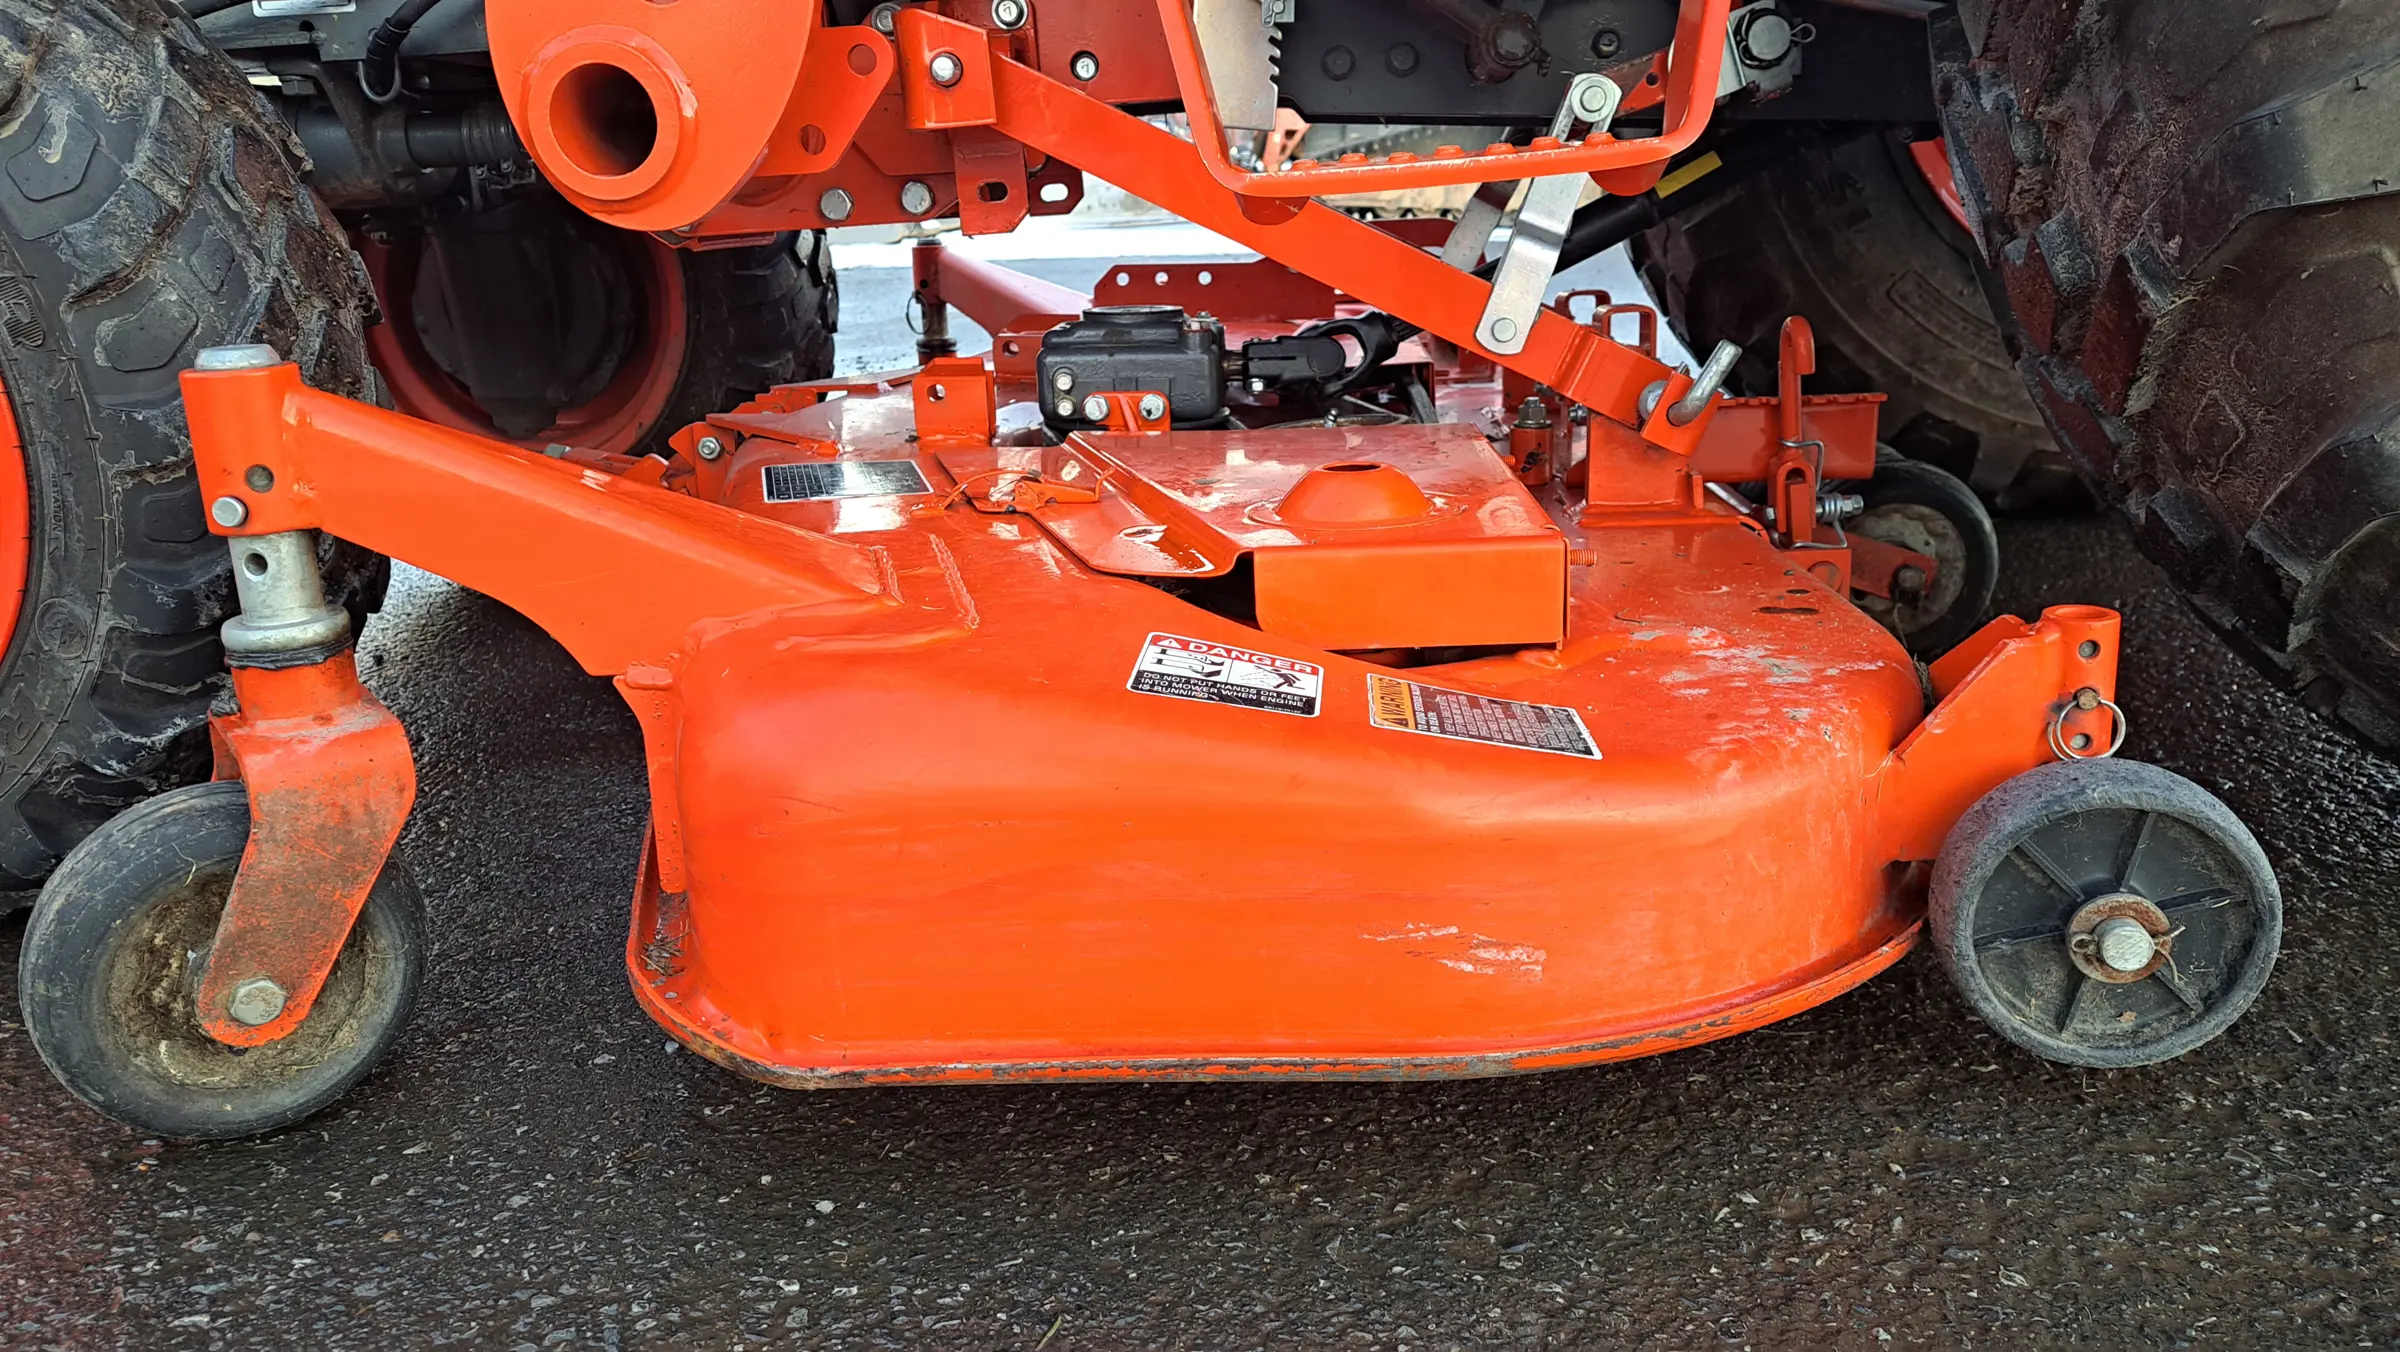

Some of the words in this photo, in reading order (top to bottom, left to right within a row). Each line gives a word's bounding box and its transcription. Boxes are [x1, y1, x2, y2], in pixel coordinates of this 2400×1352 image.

[1188, 642, 1313, 674] DANGER
[1141, 678, 1169, 688] INTO
[1172, 682, 1218, 694] MOWER
[1221, 689, 1257, 699] WHEN
[1260, 695, 1304, 707] ENGINE
[1143, 672, 1160, 680] DO
[1164, 674, 1187, 683] NOT
[1190, 678, 1213, 687] PUT
[1217, 682, 1251, 693] HANDS
[1260, 688, 1277, 696] OR
[1281, 692, 1308, 702] FEET
[1153, 686, 1209, 699] RUNNING
[1377, 677, 1405, 716] WARNING
